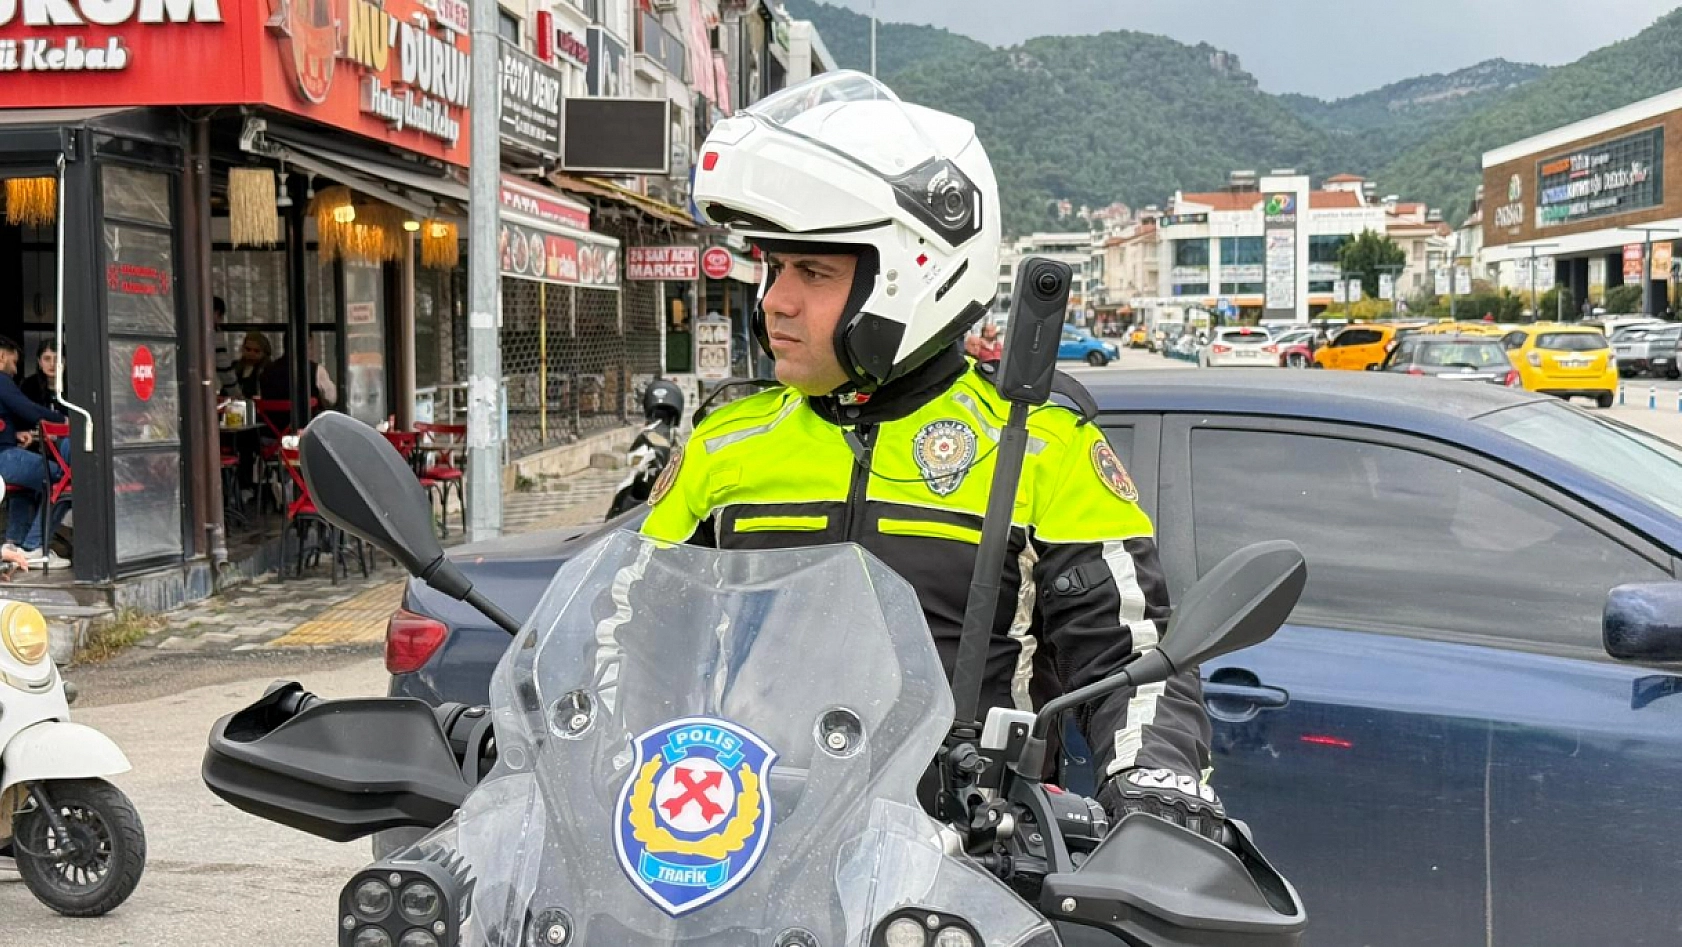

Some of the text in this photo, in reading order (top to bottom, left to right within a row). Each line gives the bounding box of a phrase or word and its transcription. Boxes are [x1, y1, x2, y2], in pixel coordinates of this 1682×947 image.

[23, 37, 127, 70] Kebab
[503, 54, 530, 101] FOTO
[645, 249, 670, 261] SAAT
[630, 264, 696, 277] MARKET
[677, 730, 735, 750] POLİS
[658, 866, 707, 883] TRAFİK
